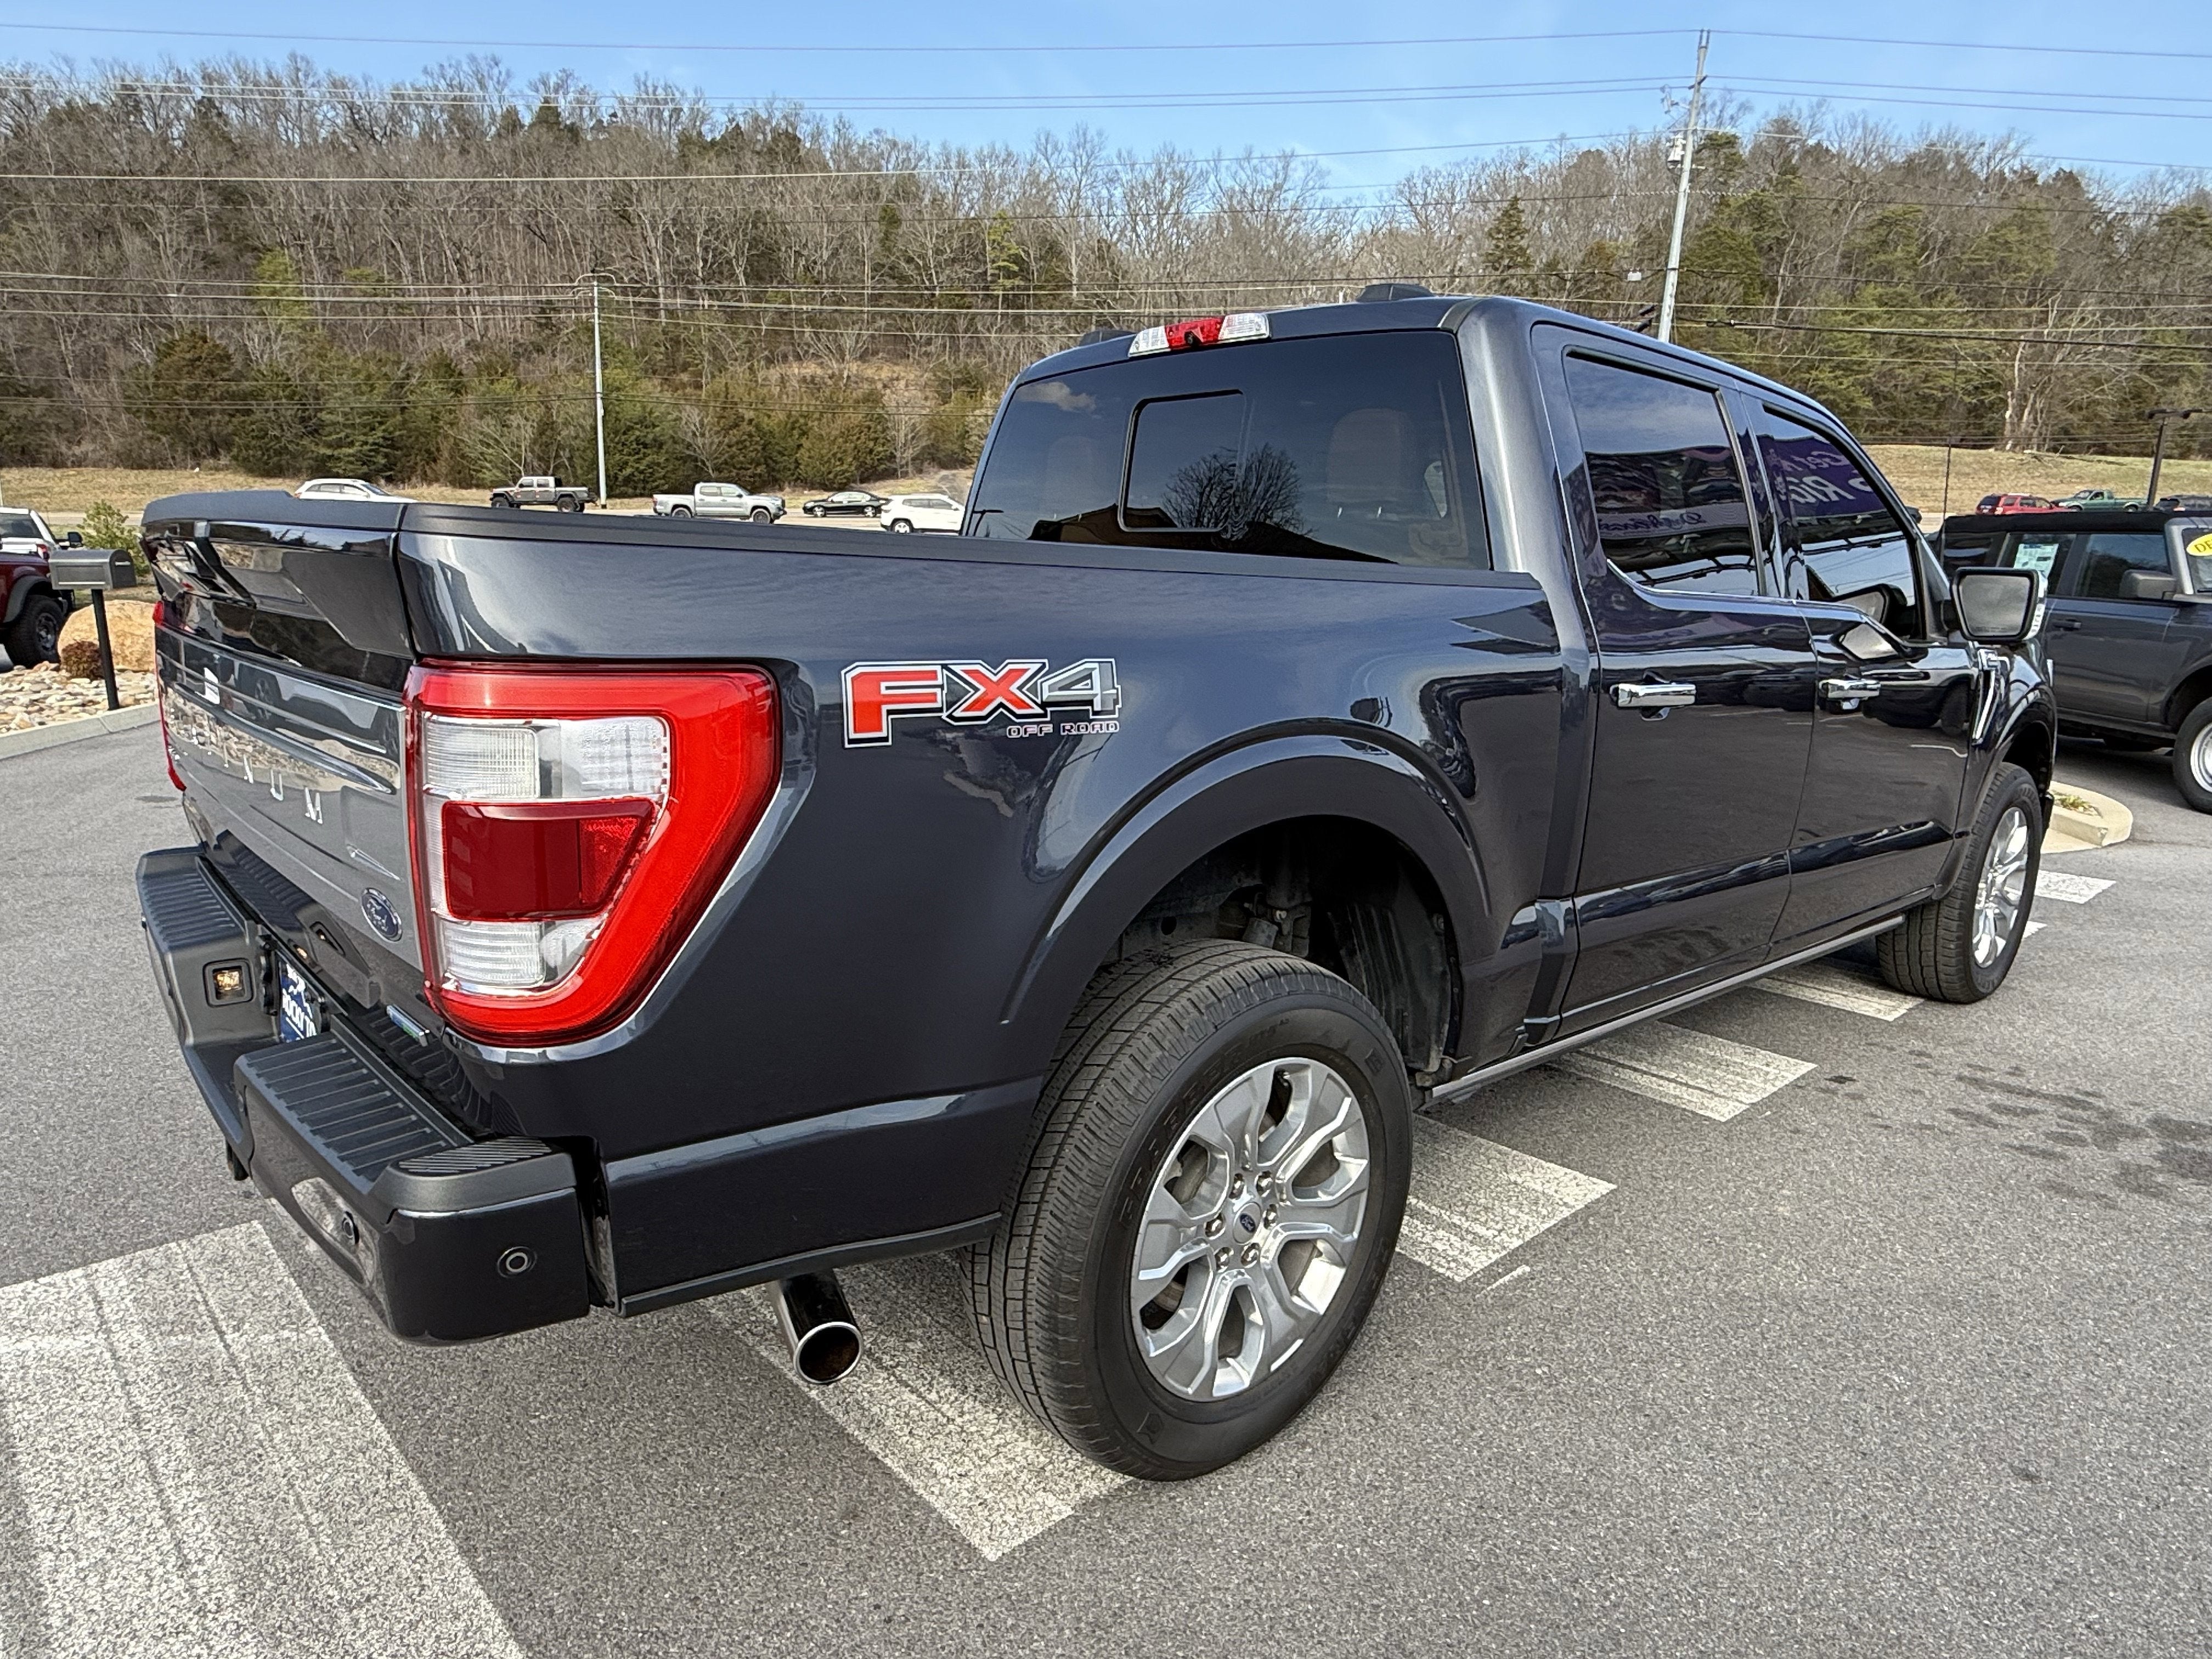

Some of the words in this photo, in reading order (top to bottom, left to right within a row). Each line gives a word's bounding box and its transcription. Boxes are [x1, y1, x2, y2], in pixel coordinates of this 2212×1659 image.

[841, 658, 1122, 748] FX4
[1006, 723, 1054, 738] OFF
[1060, 721, 1120, 735] ROAD
